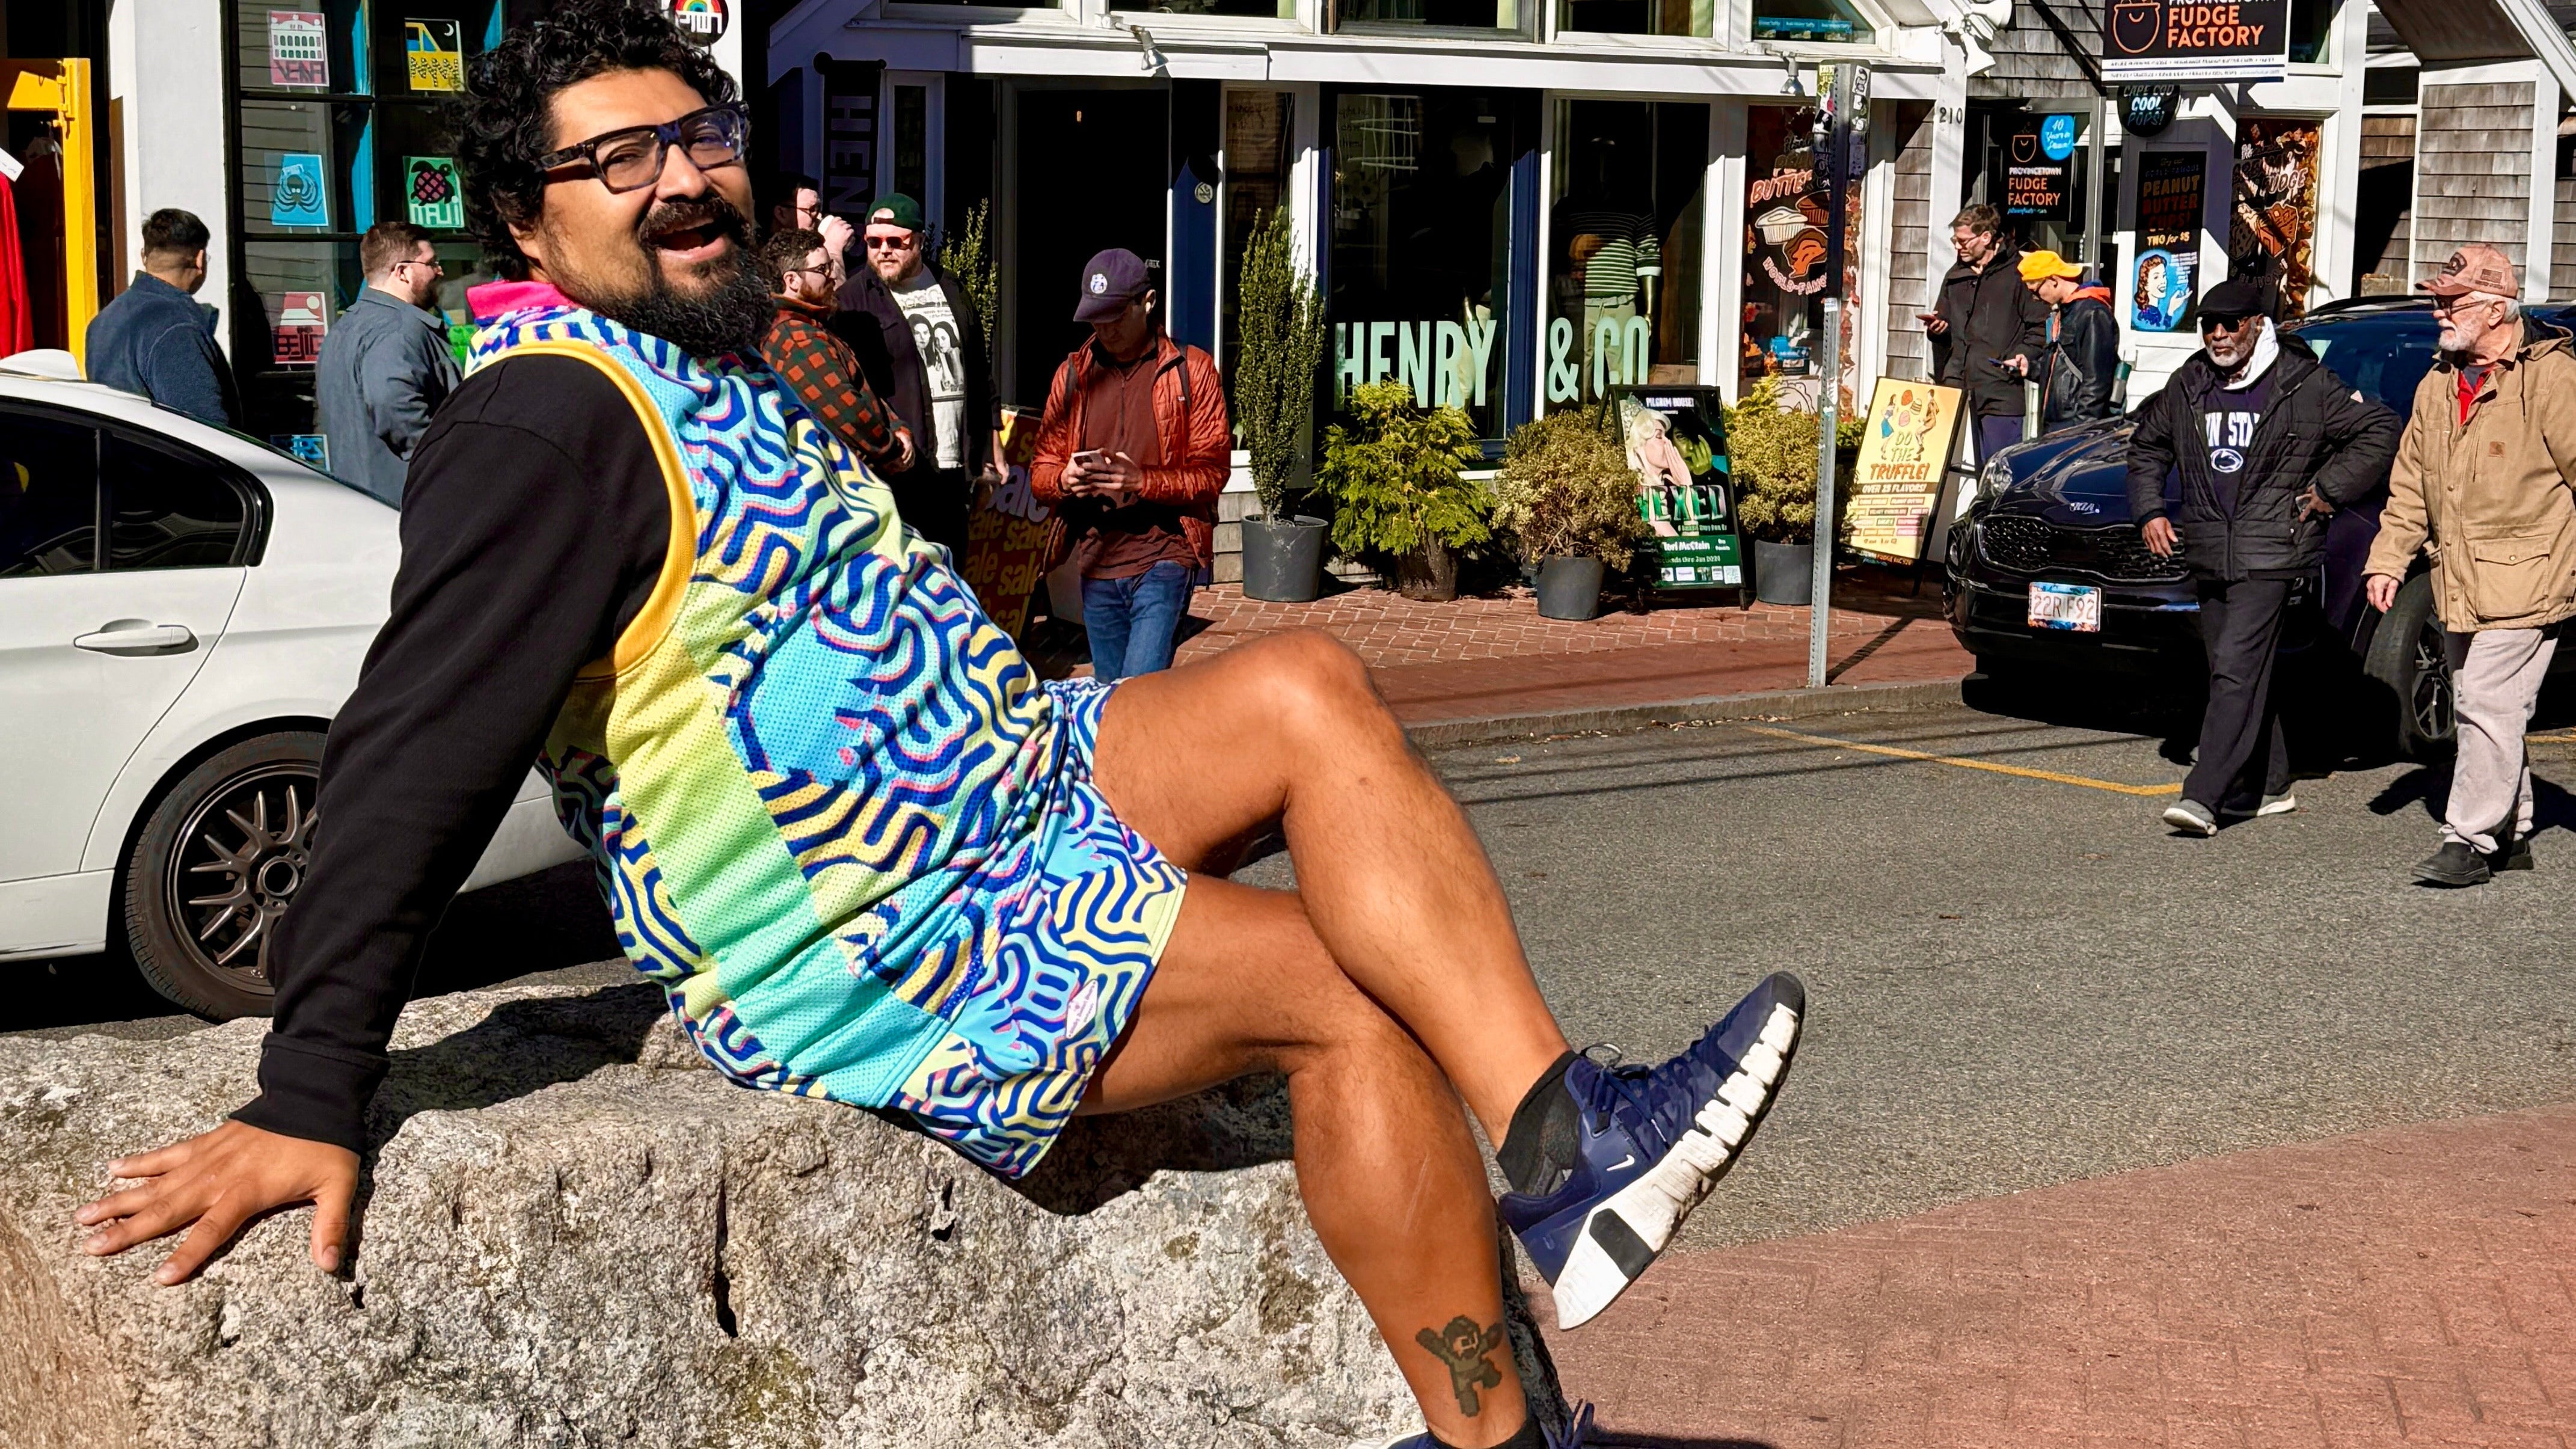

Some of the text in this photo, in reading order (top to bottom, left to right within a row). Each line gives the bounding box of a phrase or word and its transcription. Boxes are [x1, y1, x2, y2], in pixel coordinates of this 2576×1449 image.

[2168, 5, 2240, 27] FUDGE
[2168, 25, 2265, 48] FACTORY
[2124, 84, 2174, 97] CAPE COD
[2131, 97, 2162, 111] COOL
[1939, 107, 1963, 124] 210
[2127, 111, 2165, 126] POPS!
[2009, 177, 2047, 190] FUDGE
[2142, 175, 2200, 197] PEANUT
[2008, 192, 2061, 206] FACTORY
[2142, 194, 2198, 215] BUTTER
[2147, 234, 2165, 246] TWO
[2166, 234, 2179, 245] for
[1762, 256, 1827, 295] WORLD-FAMO
[1333, 315, 1649, 411] HENRY & CO
[2228, 412, 2260, 447] STA
[1895, 431, 1913, 446] DO
[1891, 447, 1915, 462] THE
[1870, 462, 1931, 480] TRUFFLE!
[987, 465, 1050, 523] ale
[1862, 484, 1881, 494] OVER
[968, 511, 1004, 541] ale
[1661, 541, 1678, 551] Tori
[964, 542, 999, 584] ale
